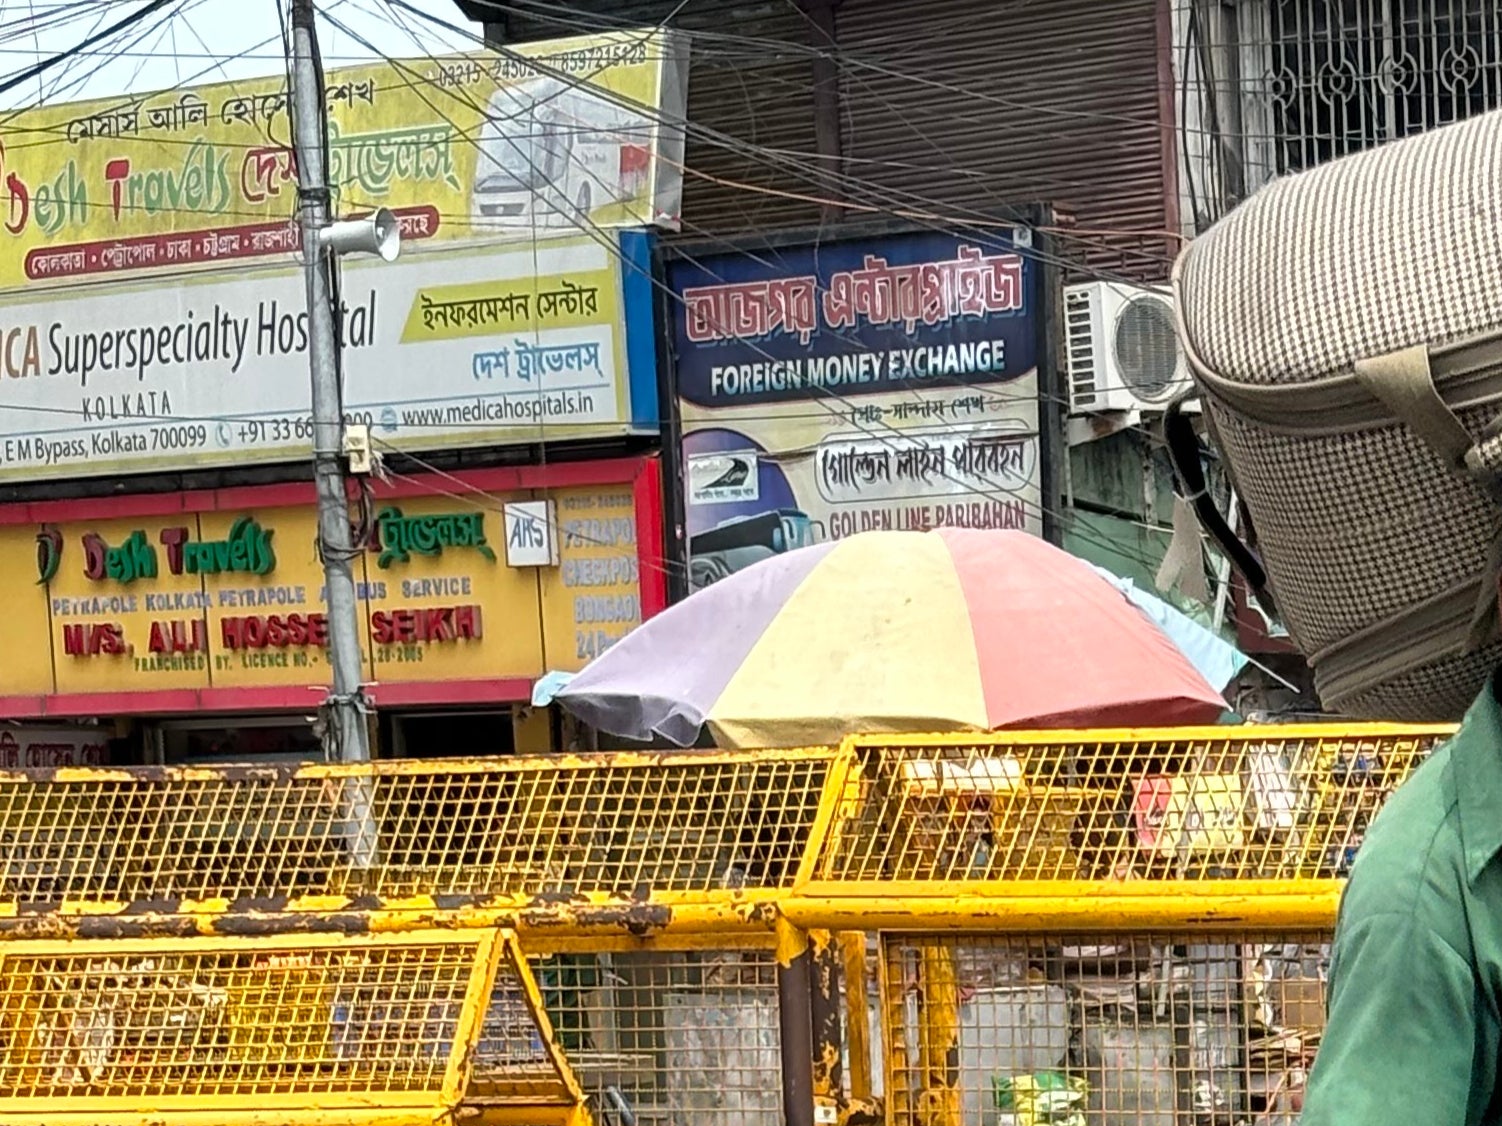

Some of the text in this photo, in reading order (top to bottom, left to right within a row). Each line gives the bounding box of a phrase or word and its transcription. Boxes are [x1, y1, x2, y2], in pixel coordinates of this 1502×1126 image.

[147, 93, 208, 131] আলি
[5, 138, 230, 234] Desh Travels
[420, 281, 599, 331] ইনফরমেশন সেন্টার
[48, 304, 249, 387] Superspecialty
[472, 346, 509, 380] দেশ
[711, 340, 1006, 396] FOREIGN MONEY EXCHANGE
[82, 390, 172, 422] KOLKATA
[401, 391, 594, 427] www.medicahospitals.in
[35, 437, 89, 464] Bypass,
[92, 431, 147, 455] Kolkata
[150, 424, 207, 450] 700099
[935, 500, 1026, 529] PARIBAHAN
[82, 516, 276, 584] Desh Travels
[145, 591, 213, 611] KOLKATA
[402, 576, 472, 599] SERVICE
[148, 618, 208, 656] ALI
[371, 604, 484, 645] SEIKH
[134, 653, 205, 672] FRANCHISED
